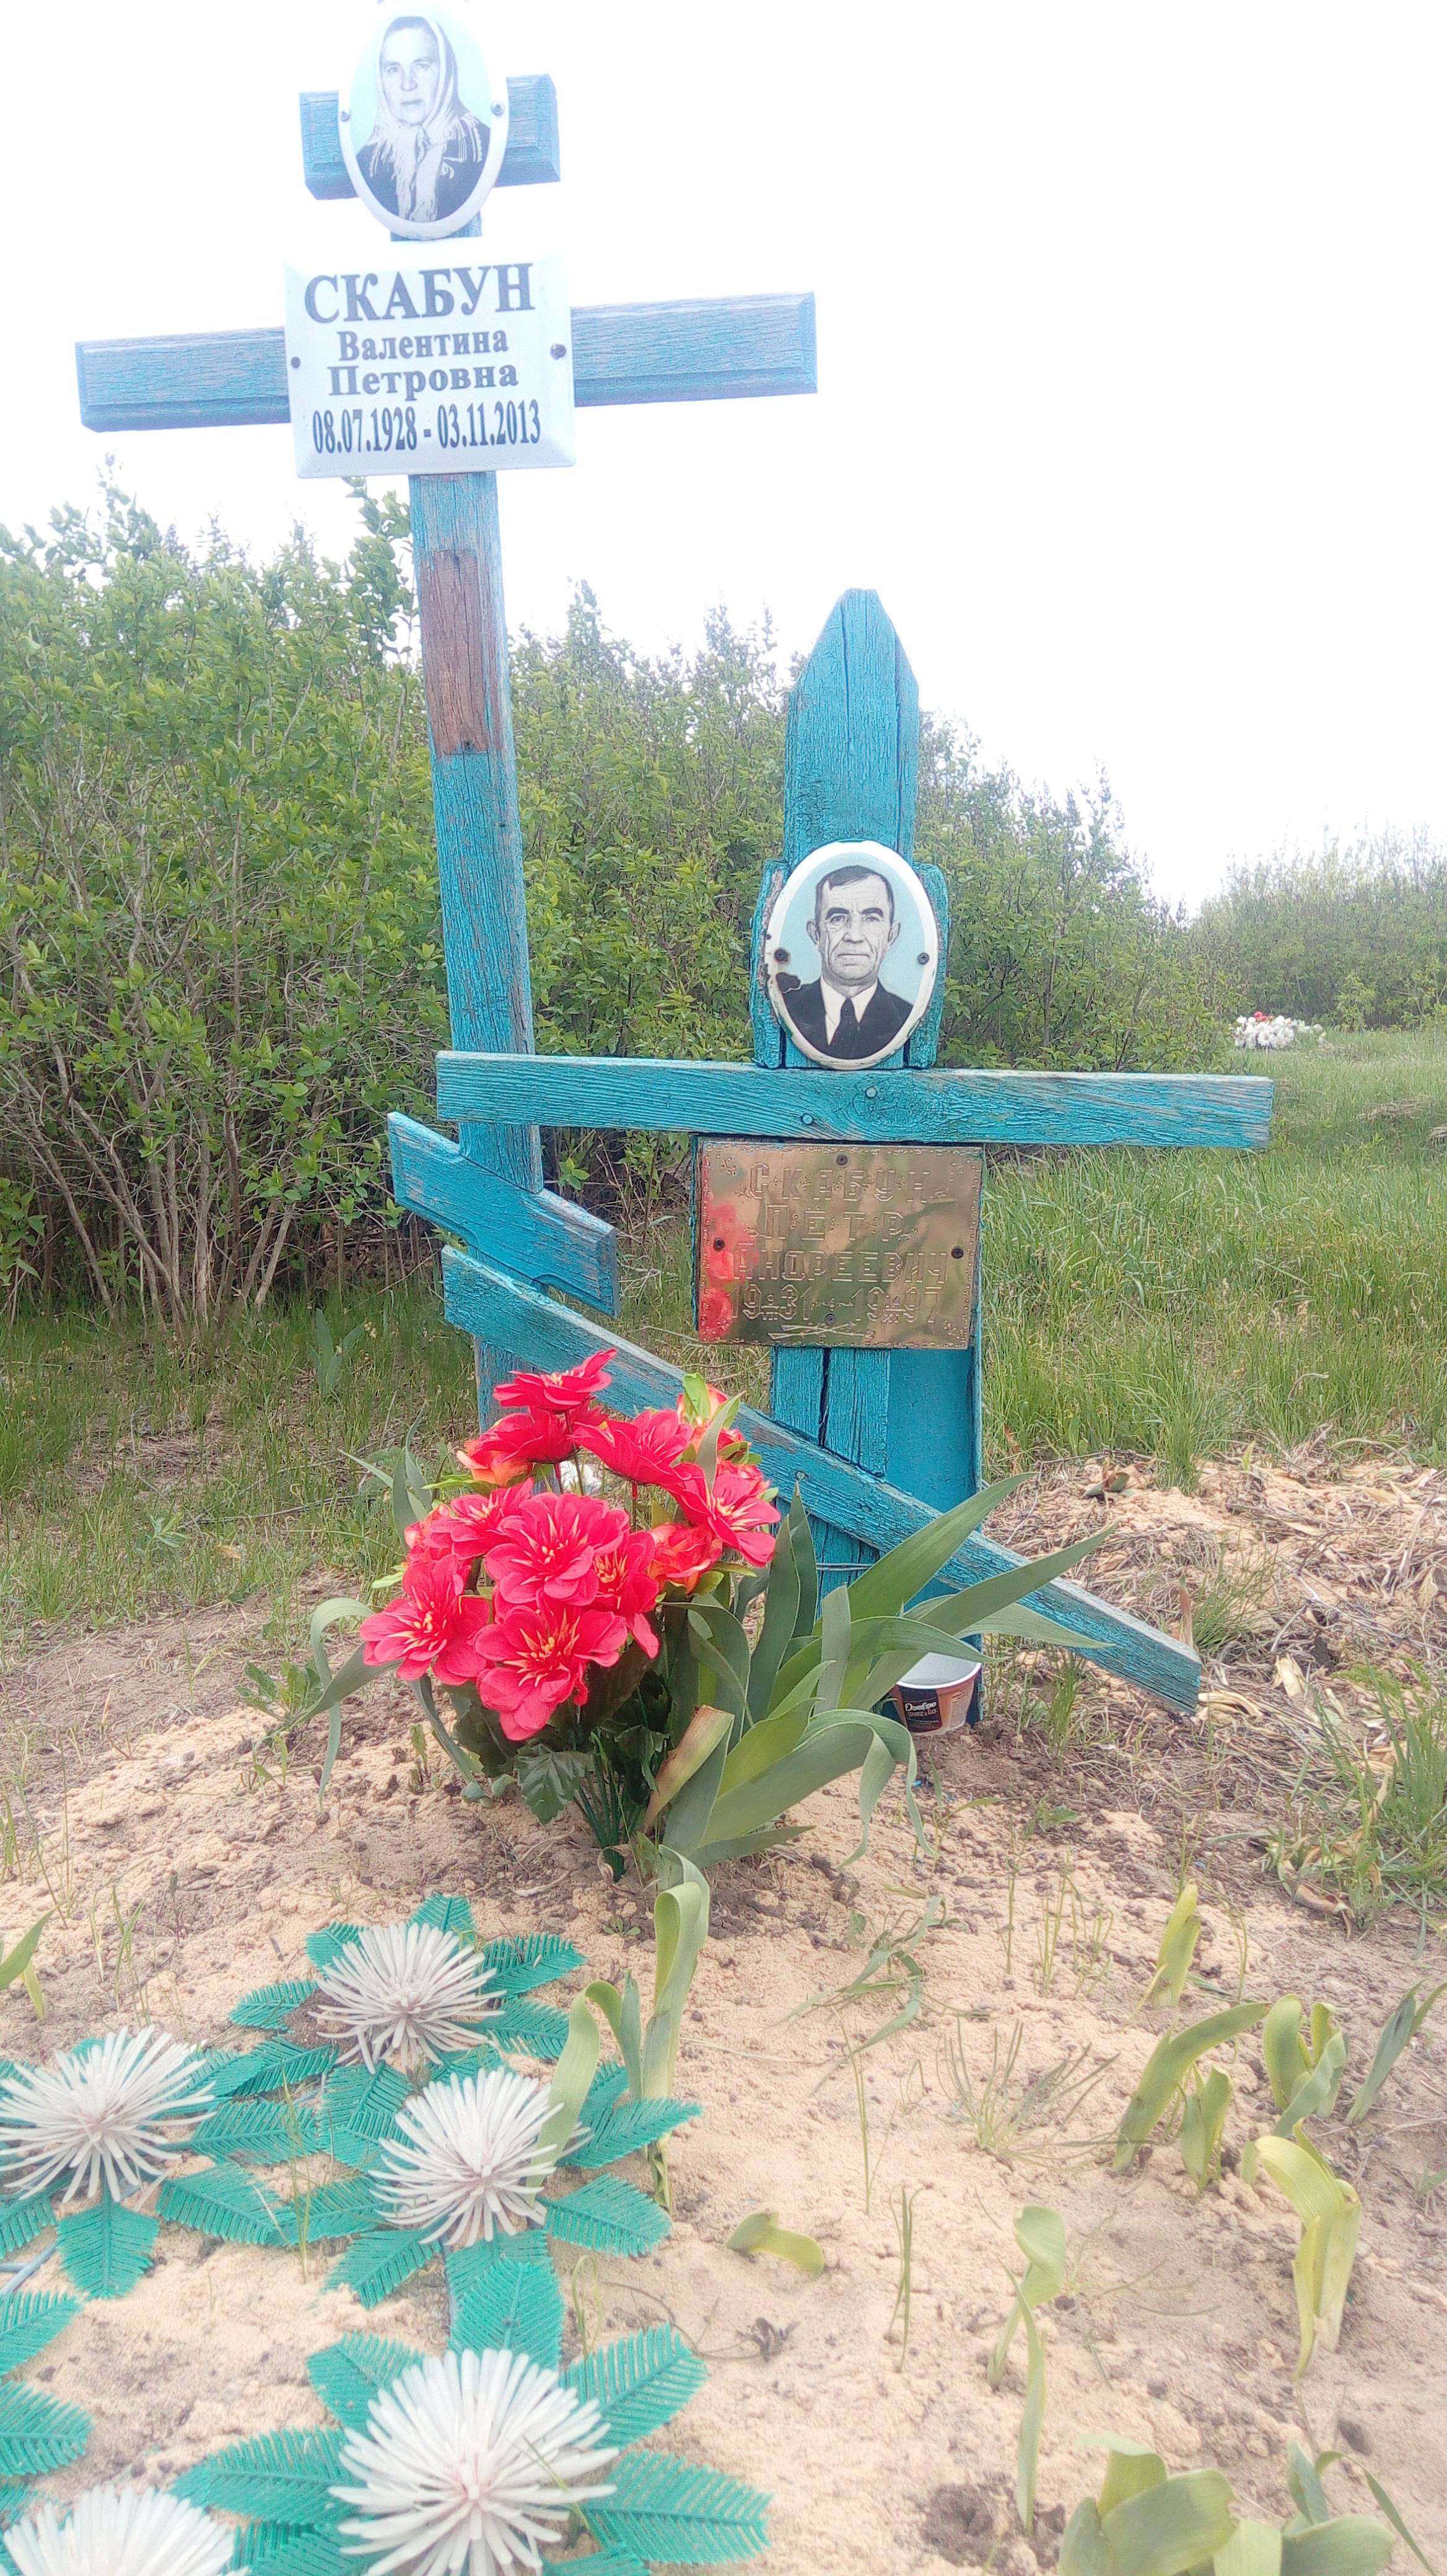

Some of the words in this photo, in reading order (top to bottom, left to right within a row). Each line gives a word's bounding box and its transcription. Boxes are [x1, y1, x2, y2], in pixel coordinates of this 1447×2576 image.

[304, 263, 536, 323] СКАБУН
[336, 329, 509, 361] Валентина
[327, 364, 519, 401] Петровна
[312, 406, 418, 453] 08.07.1928
[437, 399, 541, 448] 03.11.2013
[750, 1162, 931, 1203] СКАБУН
